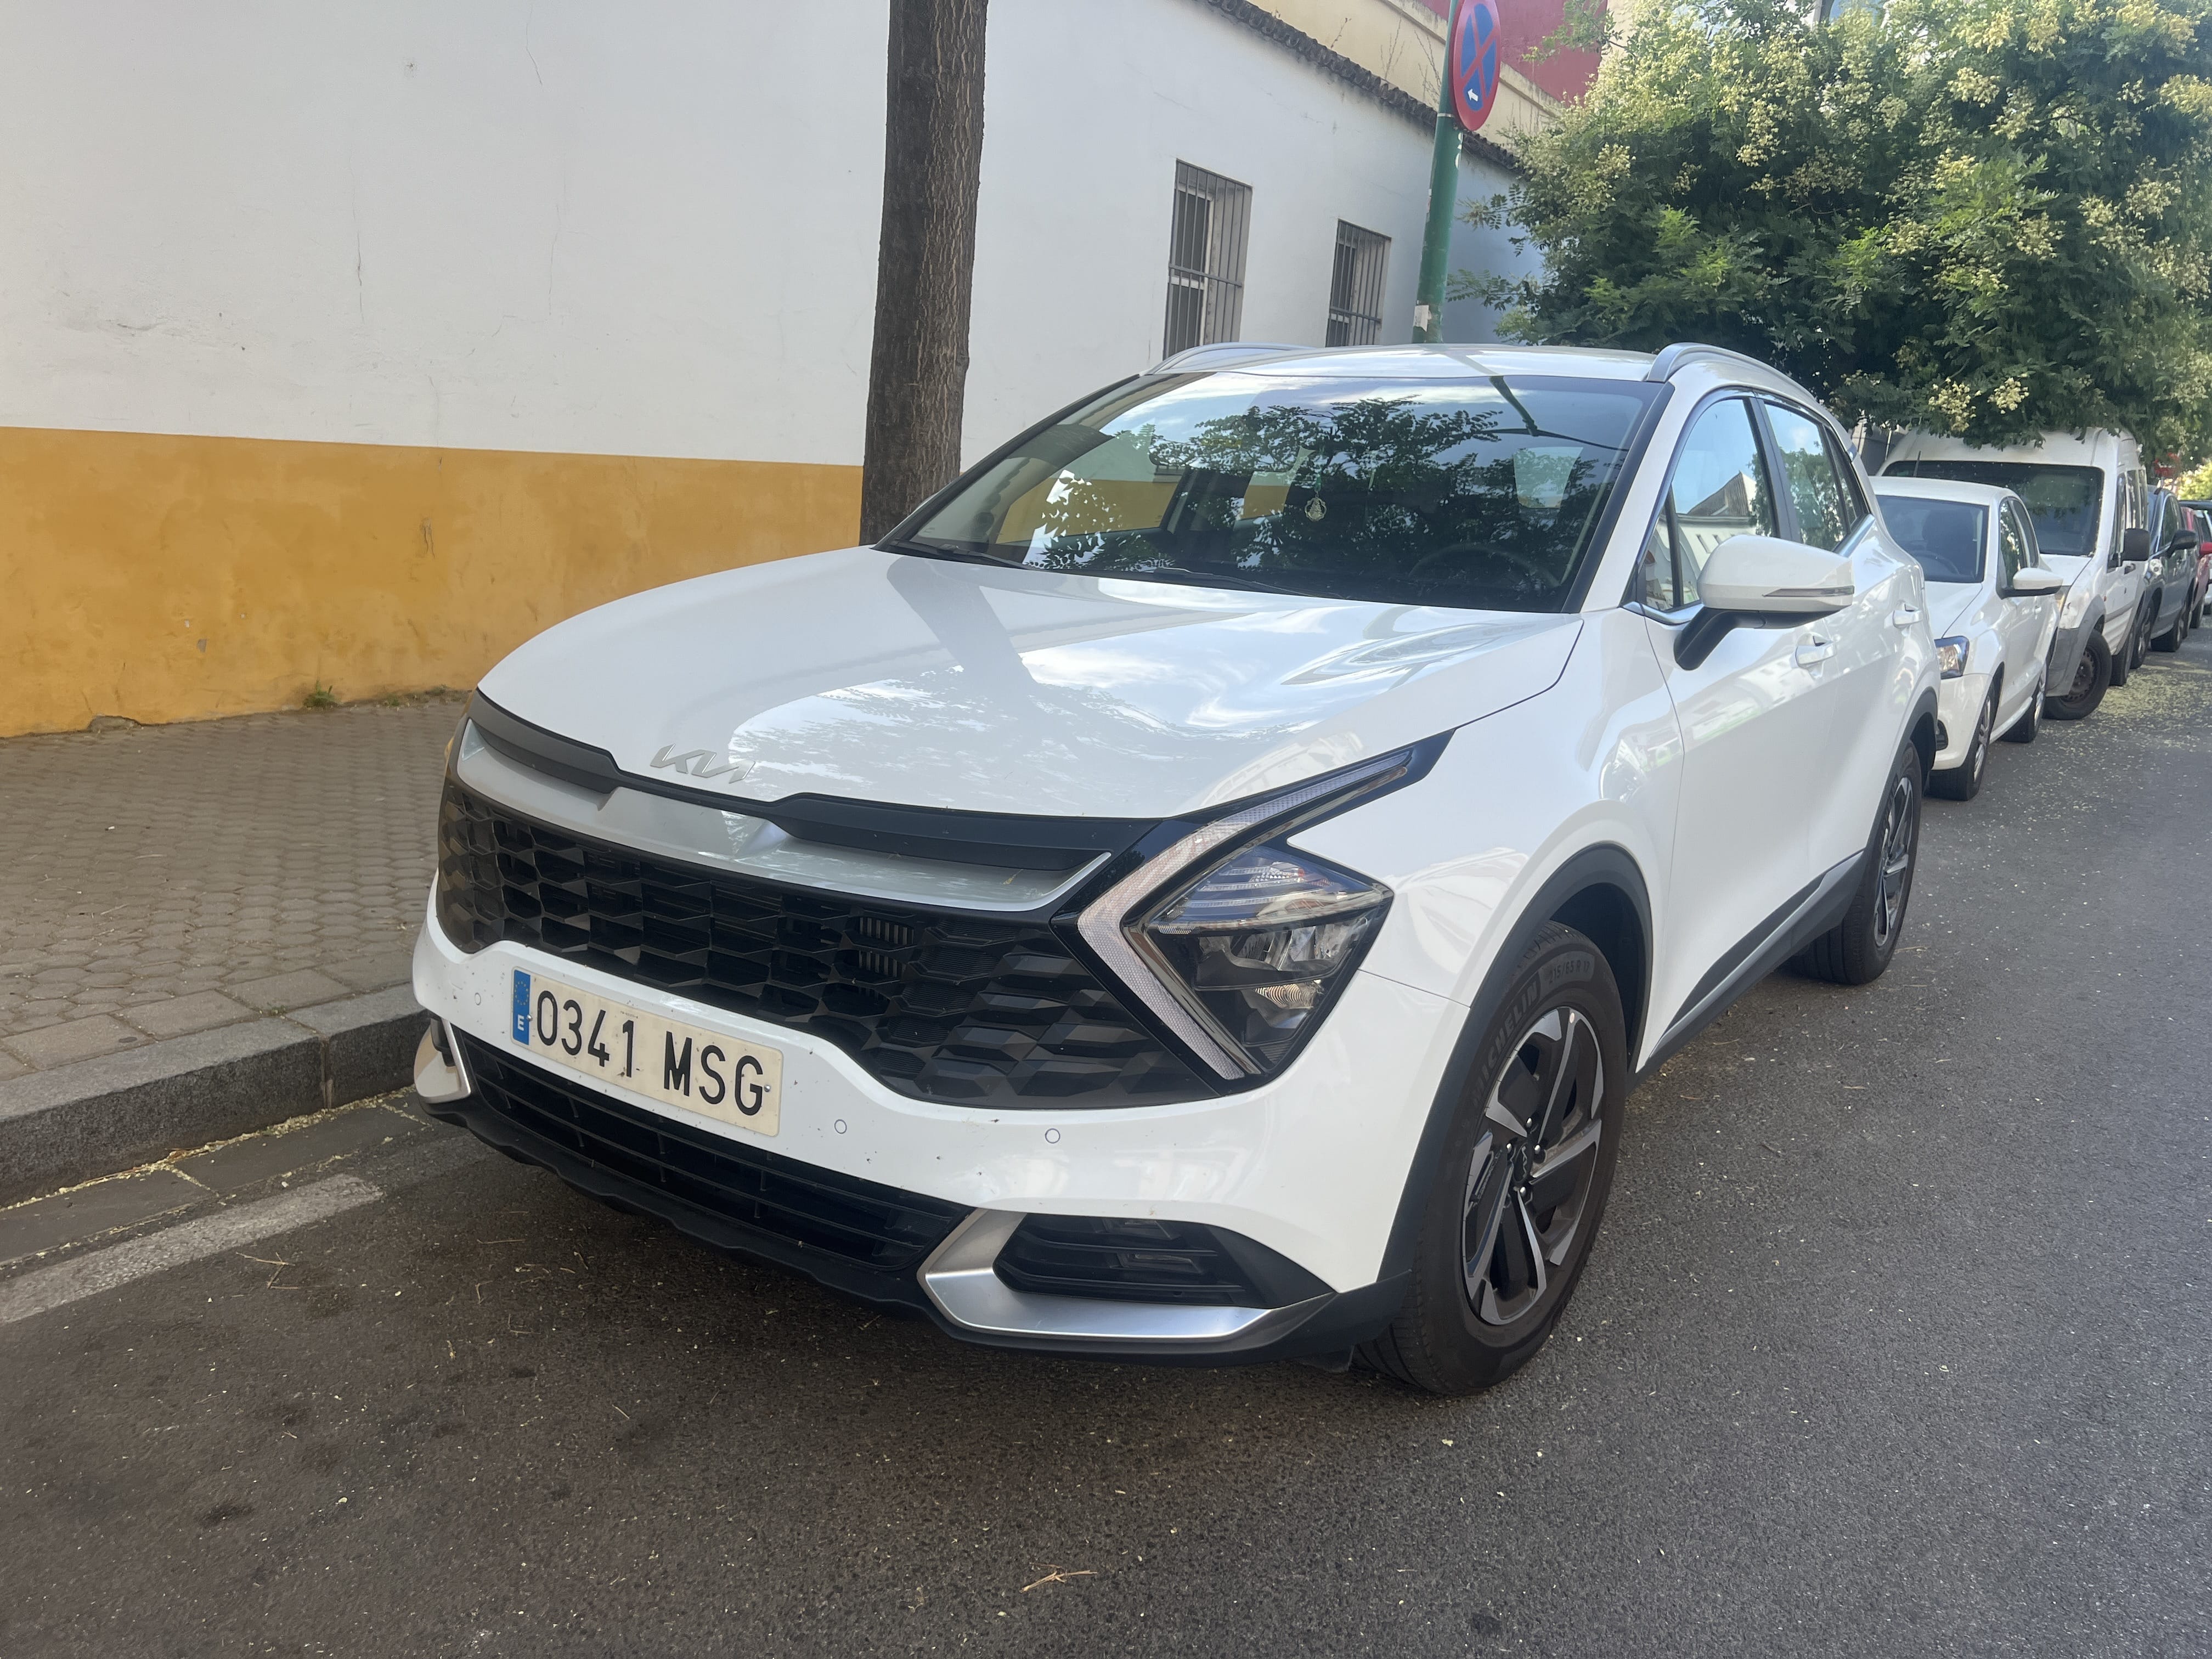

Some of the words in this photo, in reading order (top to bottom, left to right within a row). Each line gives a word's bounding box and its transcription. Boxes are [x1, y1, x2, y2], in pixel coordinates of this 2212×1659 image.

[650, 743, 756, 784] KIA
[517, 1014, 524, 1031] E
[537, 990, 634, 1078] 0341
[663, 1030, 764, 1116] MSG
[1472, 980, 1538, 1108] MICHELIN
